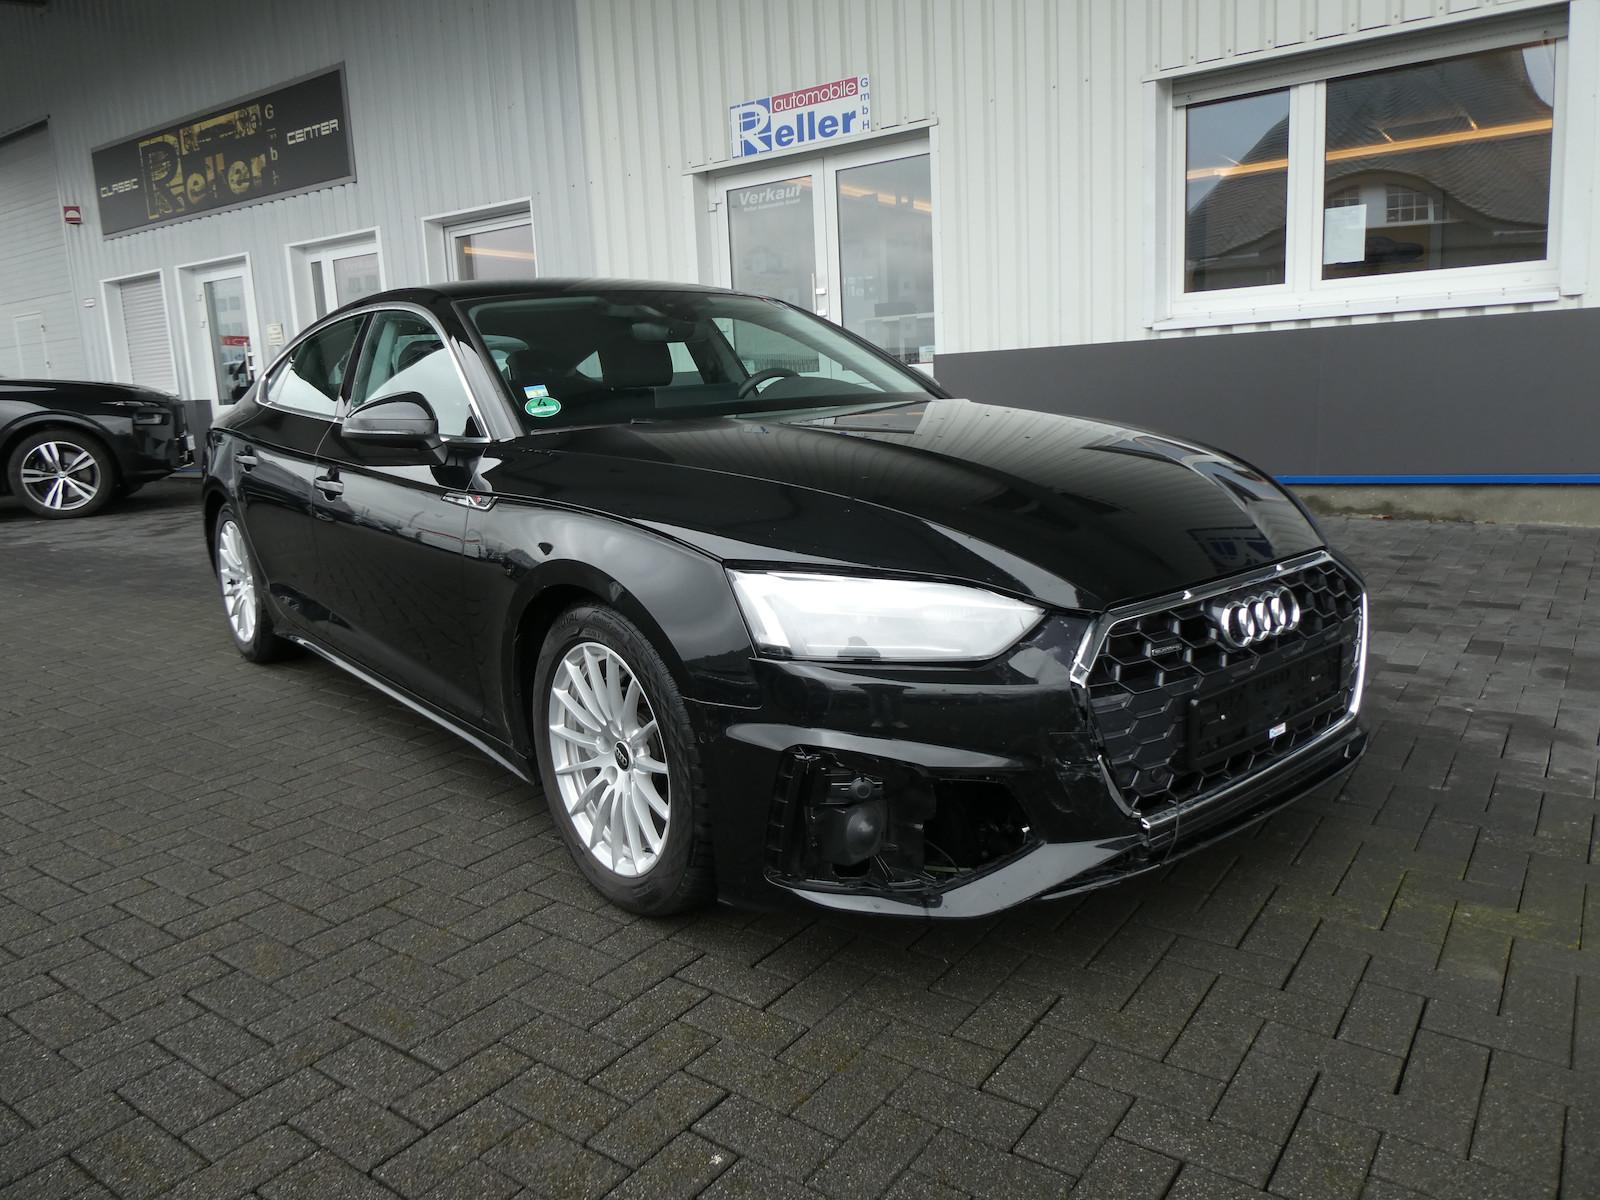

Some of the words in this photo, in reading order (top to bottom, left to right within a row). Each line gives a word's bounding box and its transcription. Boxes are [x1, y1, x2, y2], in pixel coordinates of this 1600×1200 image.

[773, 81, 857, 112] automobile
[860, 77, 870, 130] GmbH
[286, 118, 340, 145] CENTER
[730, 101, 857, 158] Reller
[100, 178, 138, 198] CLASSIC
[739, 184, 802, 206] Verkauf
